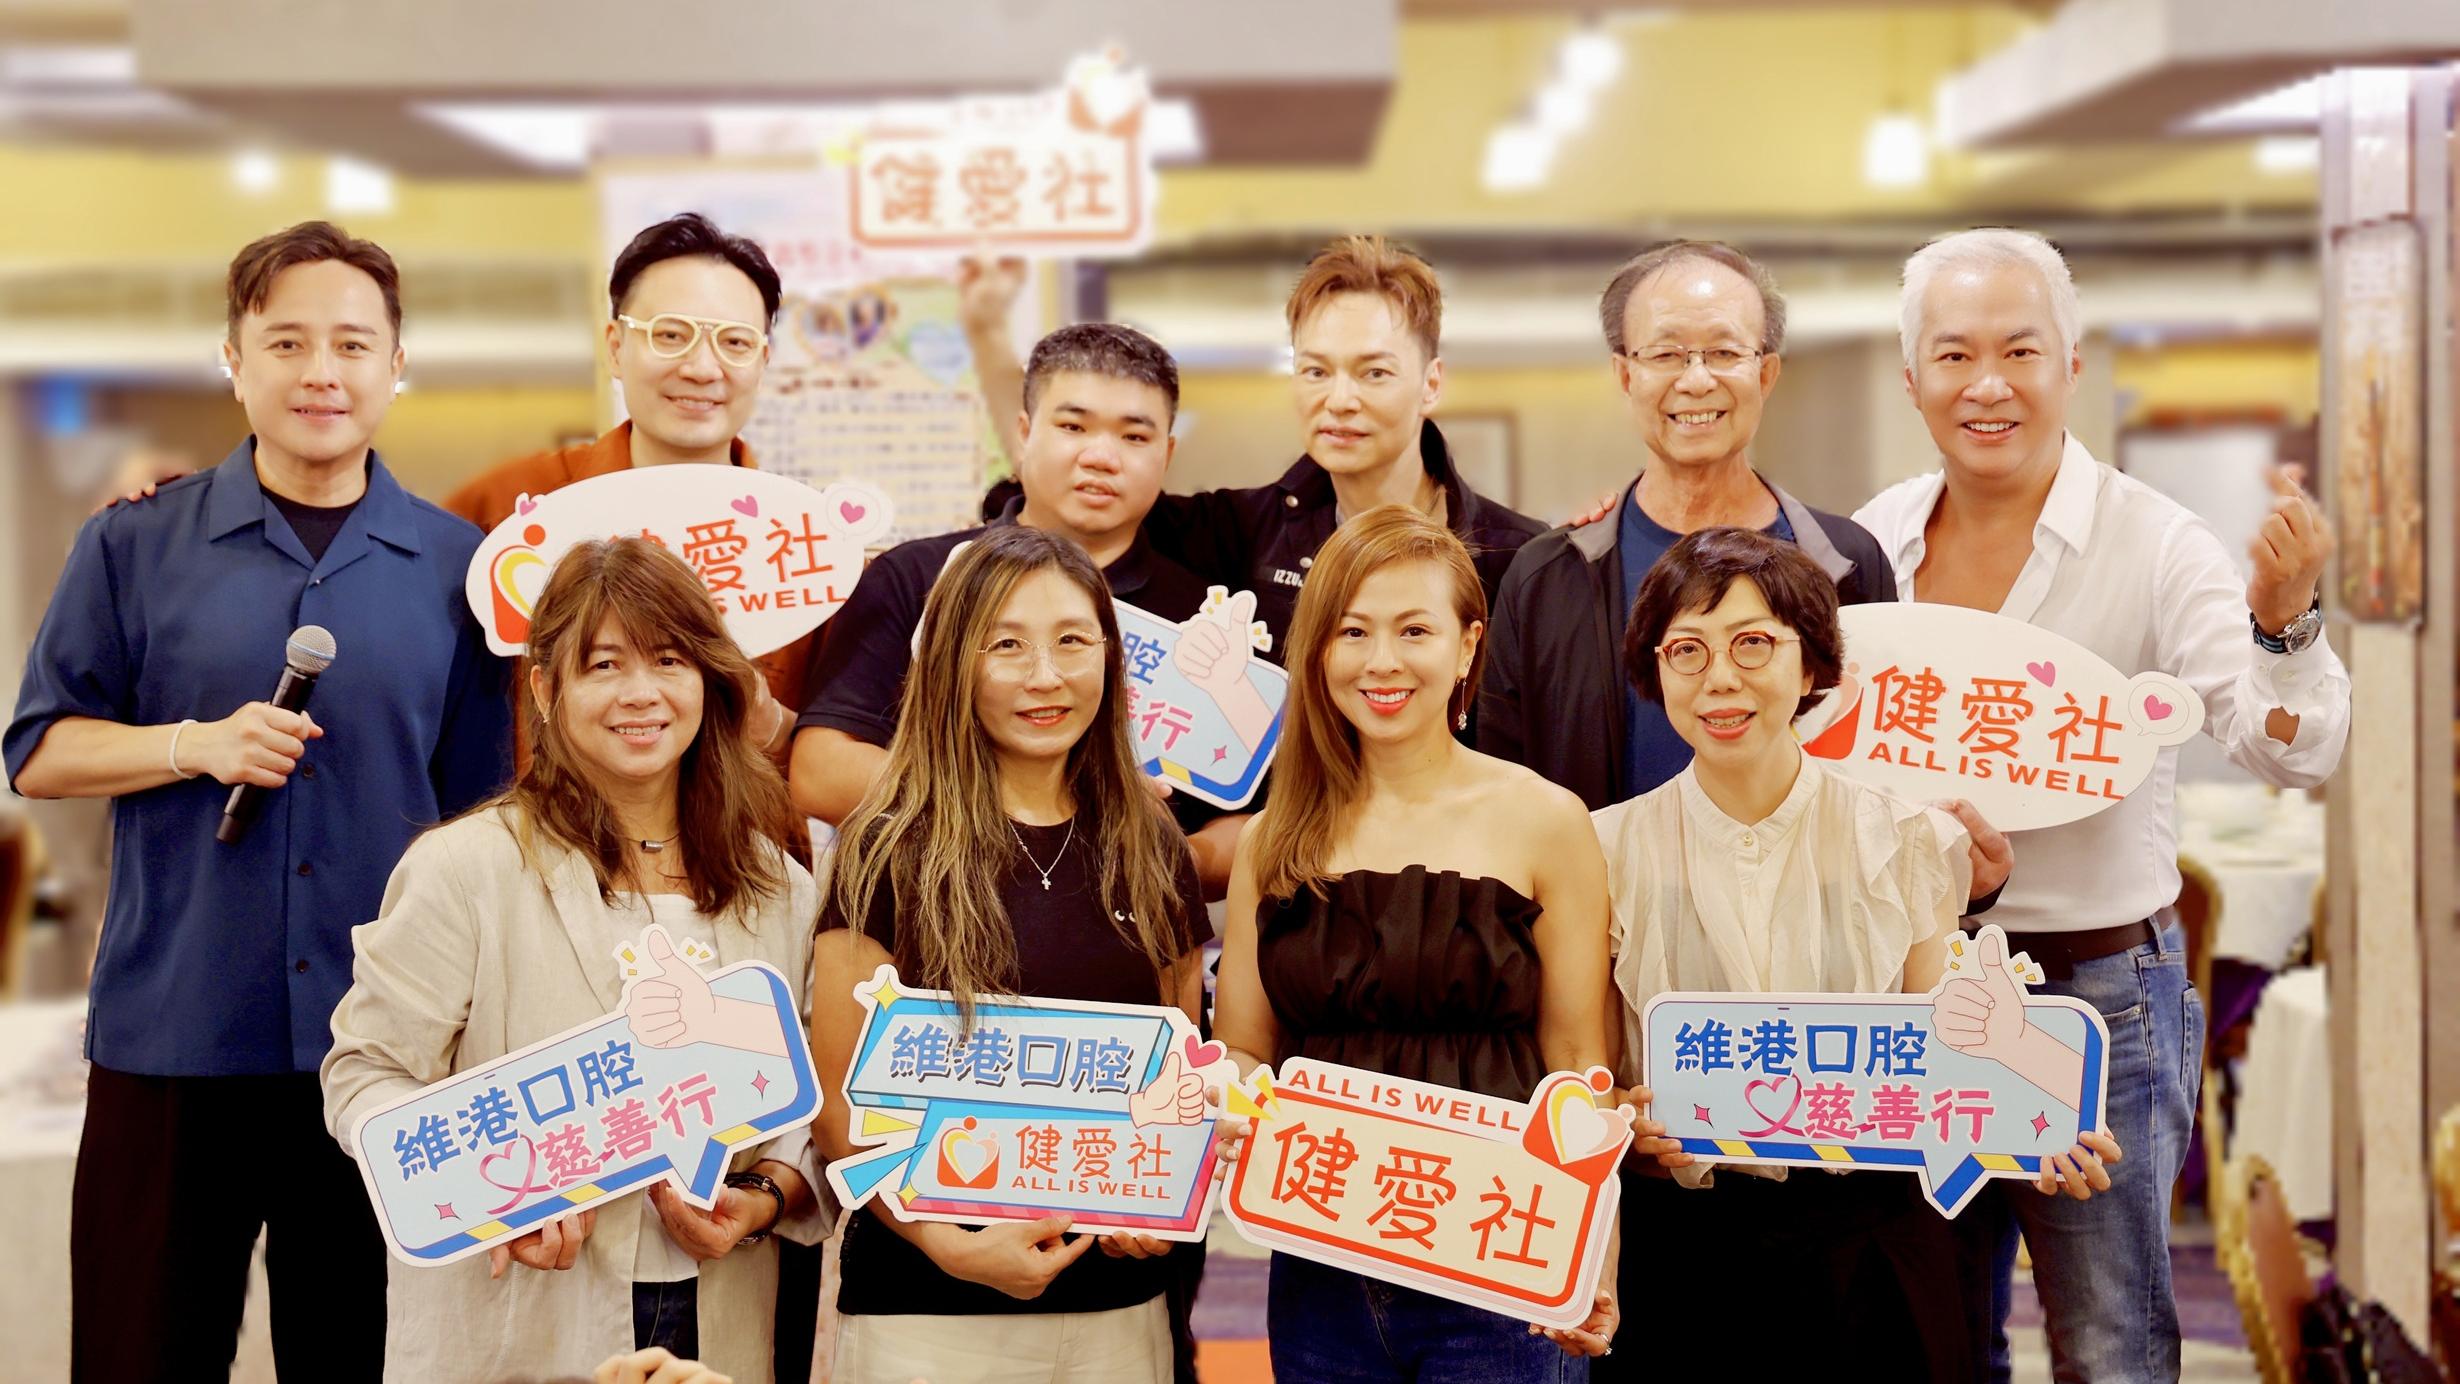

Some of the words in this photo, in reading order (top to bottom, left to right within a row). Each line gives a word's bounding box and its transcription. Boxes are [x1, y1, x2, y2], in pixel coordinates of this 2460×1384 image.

[607, 512, 834, 593] 愛社
[738, 586, 849, 613] WELL
[1872, 665, 2125, 764] 健愛社
[1867, 742, 1947, 772] ALL
[1958, 756, 1994, 778] IS
[2006, 763, 2126, 800] WELL
[890, 1024, 1134, 1093] 維港口腔
[1674, 1020, 1928, 1077] 維港口腔
[393, 1040, 645, 1181] 維港口腔
[537, 1073, 718, 1184] 慈善行
[1288, 1069, 1360, 1101] ALL
[1371, 1084, 1402, 1107] IS
[1414, 1092, 1521, 1133] WELL
[1803, 1084, 1995, 1143] 慈善行
[1014, 1124, 1173, 1180] 健愛社
[1010, 1175, 1061, 1192] ALL
[1068, 1180, 1090, 1194] IS
[1098, 1182, 1171, 1200] WELL
[1271, 1122, 1556, 1269] 健愛社
